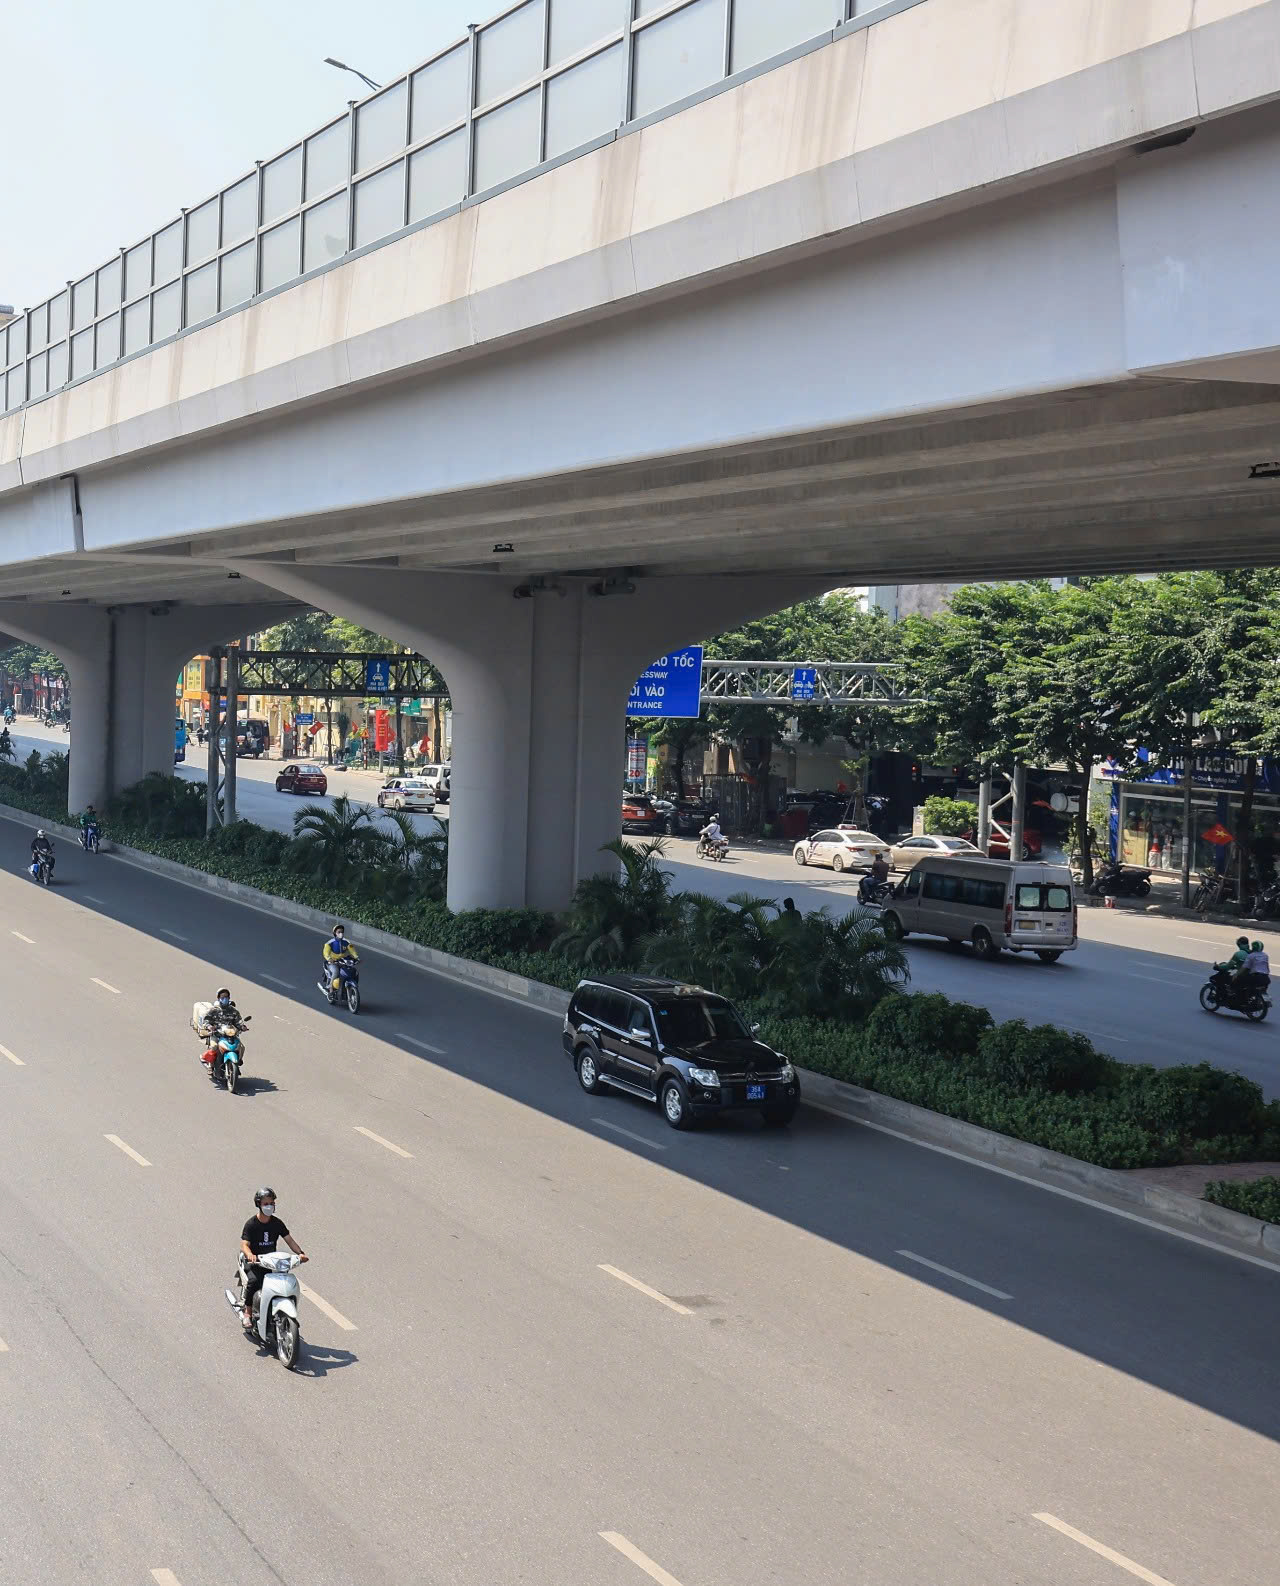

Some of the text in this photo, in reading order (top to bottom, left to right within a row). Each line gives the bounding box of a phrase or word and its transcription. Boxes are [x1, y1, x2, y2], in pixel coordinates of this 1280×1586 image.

[673, 652, 695, 667] TỐC
[645, 683, 665, 697] VÀO
[627, 701, 663, 709] NTRANCE
